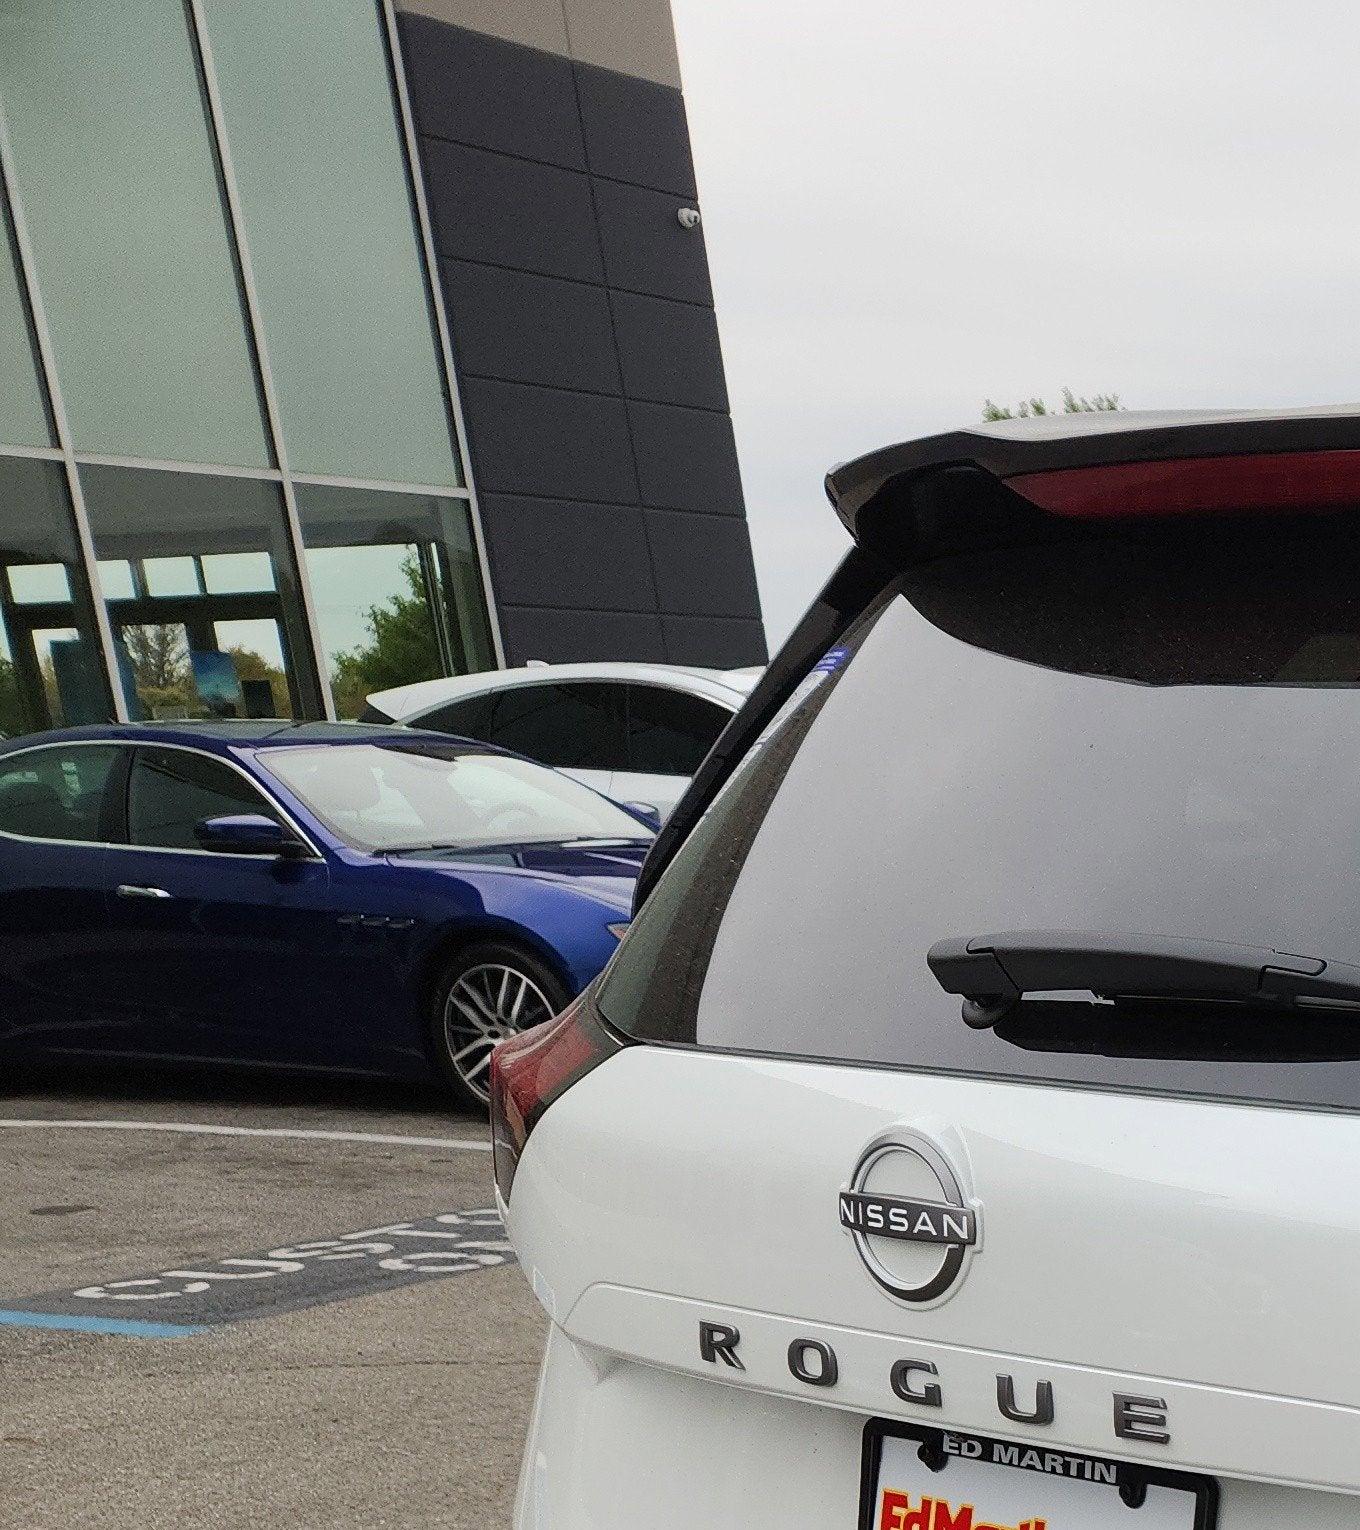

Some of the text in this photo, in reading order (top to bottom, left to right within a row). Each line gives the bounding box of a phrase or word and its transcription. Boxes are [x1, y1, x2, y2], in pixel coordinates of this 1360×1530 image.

[840, 1197, 969, 1240] NISSAN
[699, 1319, 1170, 1444] ROGUE
[942, 1433, 1118, 1484] ED MARTIN
